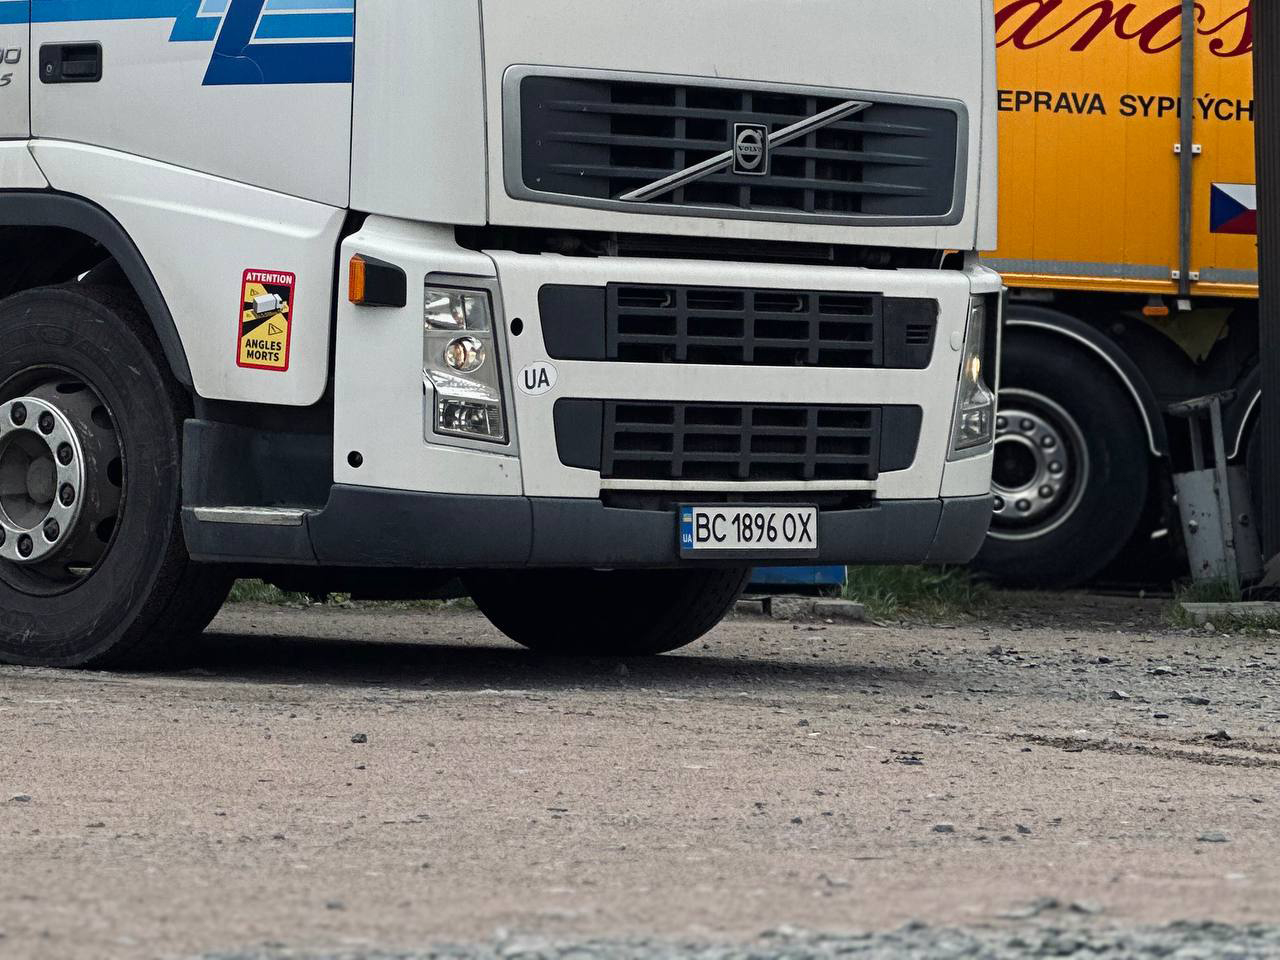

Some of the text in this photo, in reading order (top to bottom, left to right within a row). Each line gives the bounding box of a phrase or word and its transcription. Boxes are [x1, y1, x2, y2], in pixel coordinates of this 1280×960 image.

[245, 271, 293, 285] ATTENTION
[245, 338, 282, 351] ANGLES
[246, 350, 280, 362] MORTS
[524, 367, 551, 390] UA
[695, 512, 813, 543] BC 1896 OX
[682, 533, 693, 543] UA
